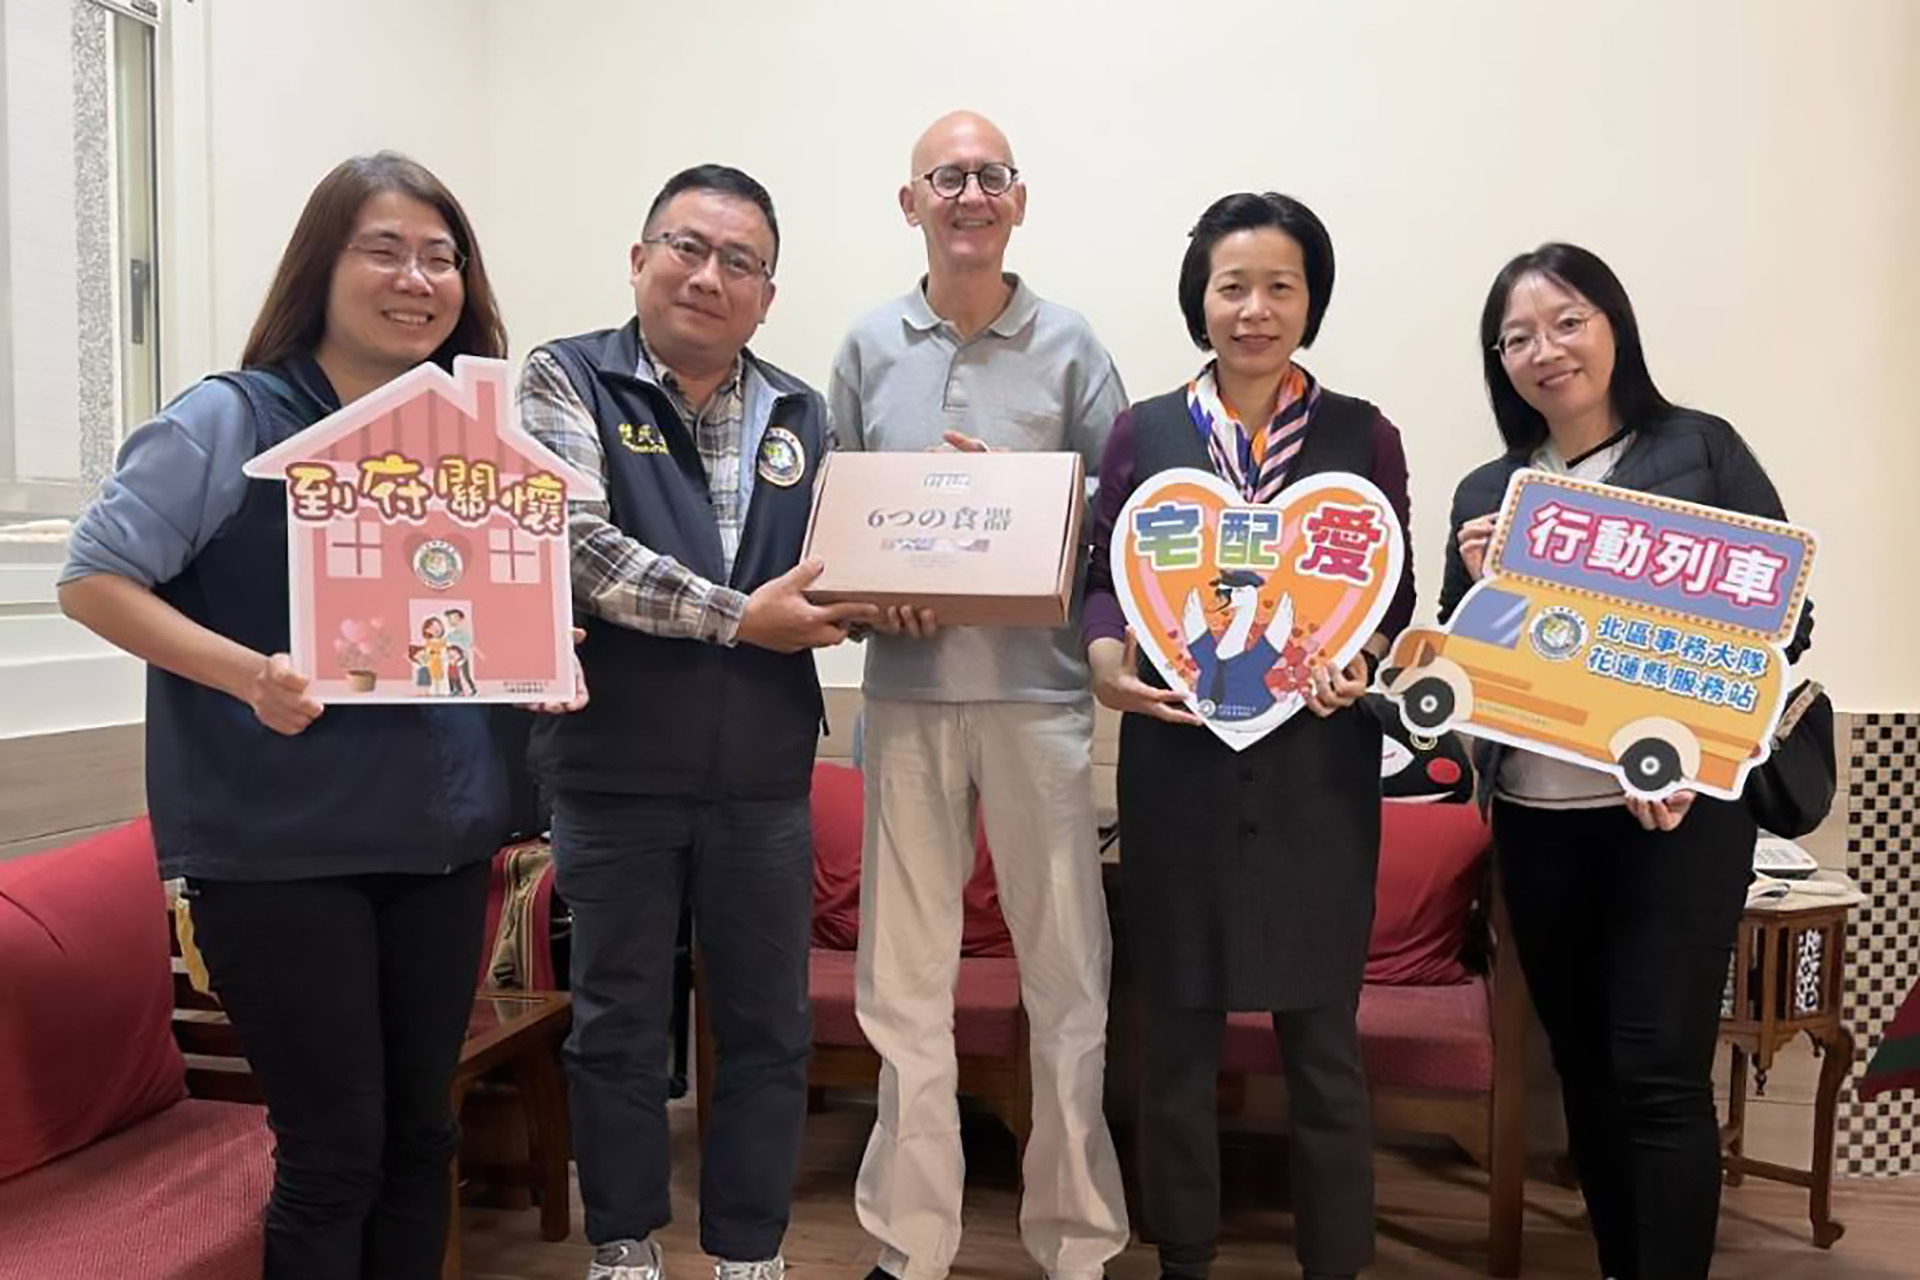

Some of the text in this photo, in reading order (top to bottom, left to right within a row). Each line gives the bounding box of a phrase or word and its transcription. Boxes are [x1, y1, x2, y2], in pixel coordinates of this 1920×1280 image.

[287, 454, 567, 535] 到府關懷
[1134, 504, 1384, 582] 宅配愛
[1528, 503, 1787, 606] 行動列車
[1588, 648, 1757, 711] 花蓮縣服務站
[1598, 614, 1768, 676] 北區事務大隊
